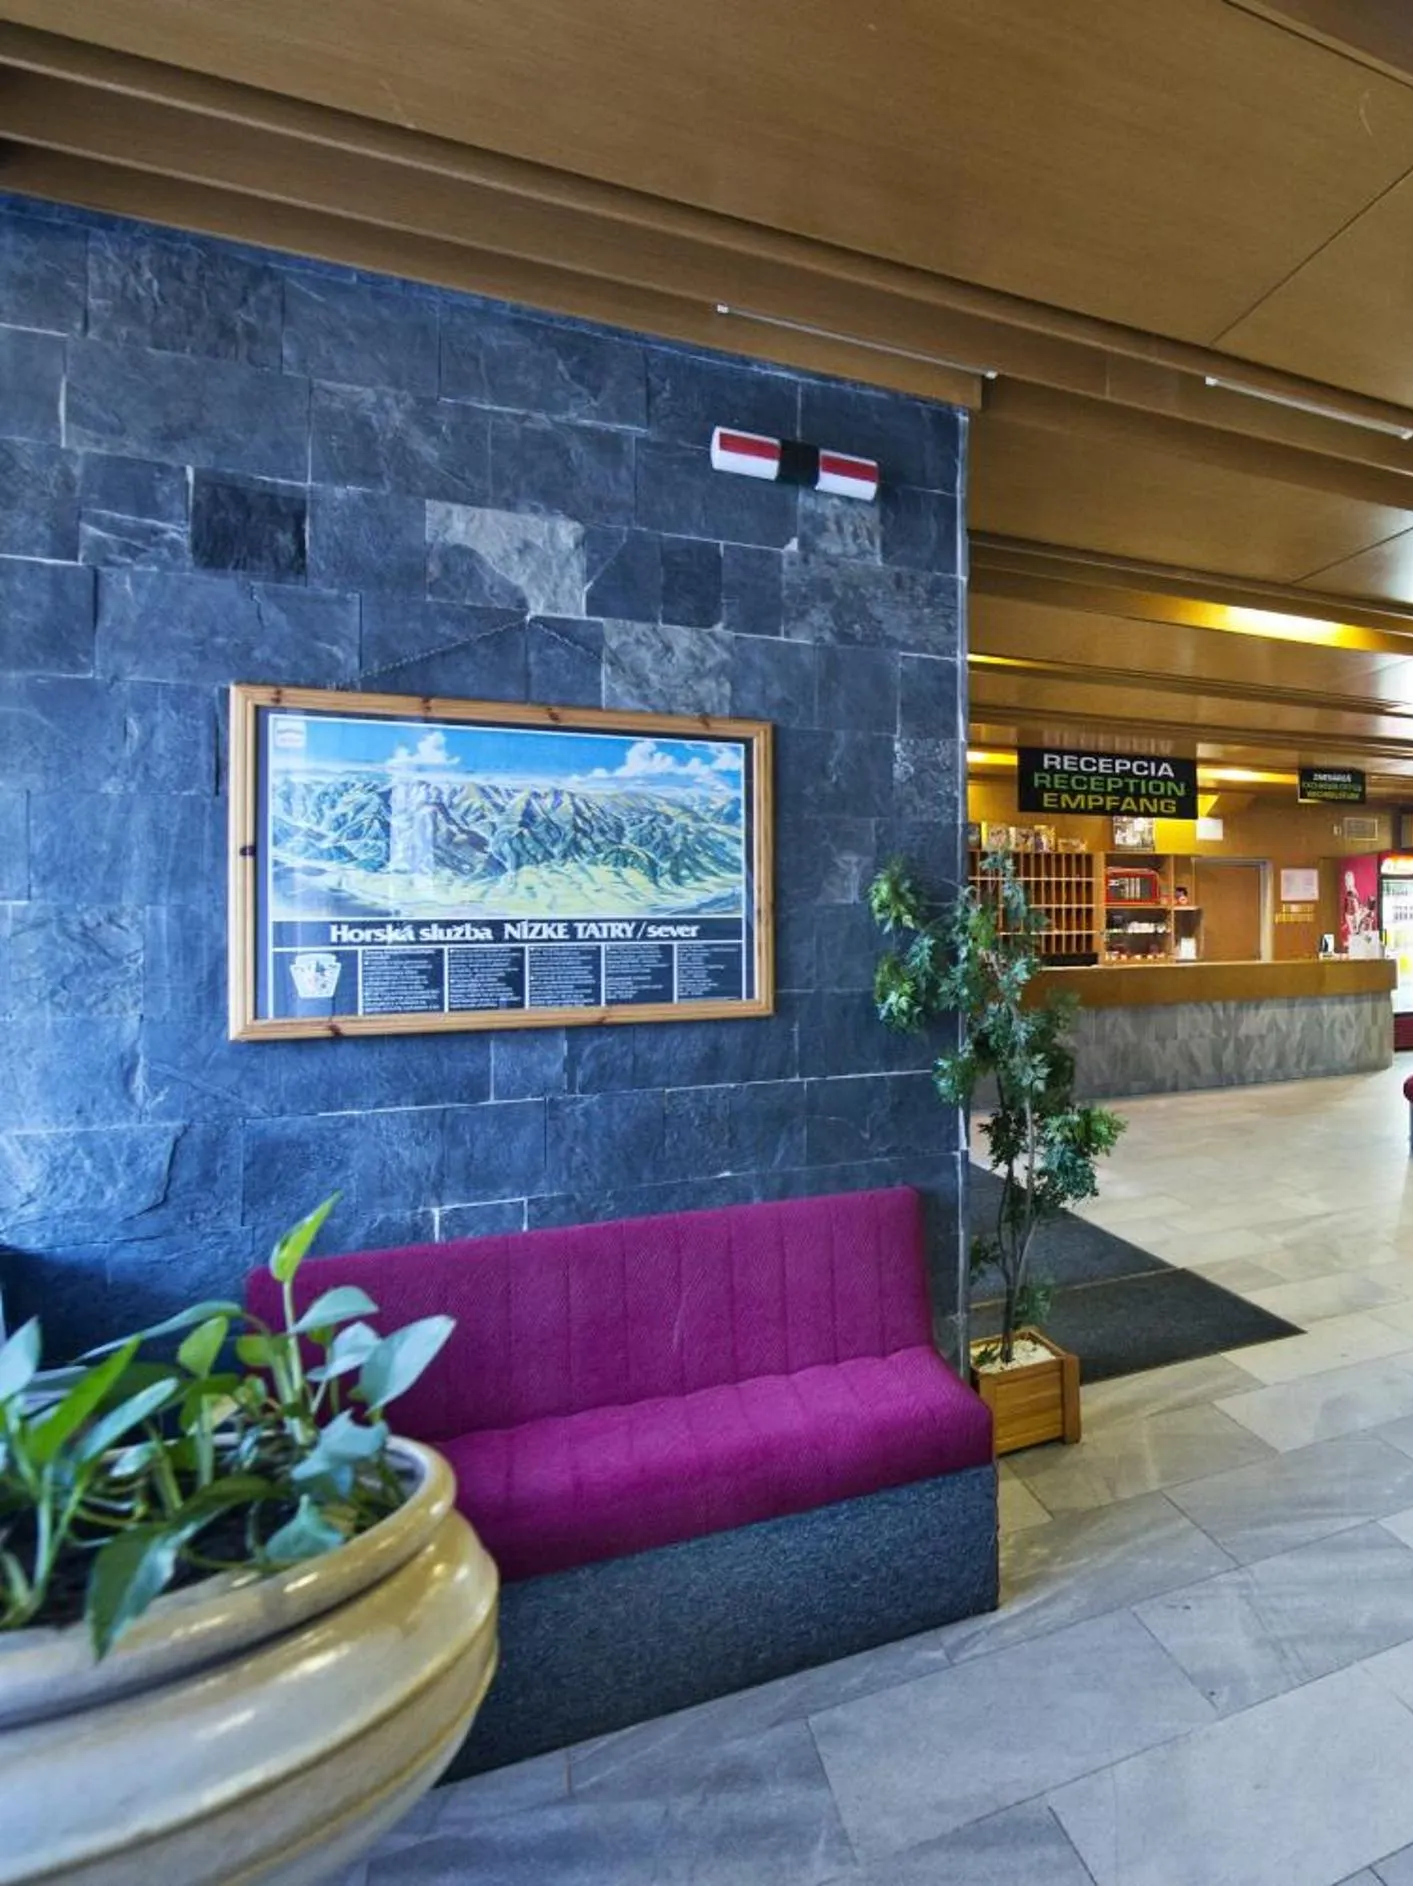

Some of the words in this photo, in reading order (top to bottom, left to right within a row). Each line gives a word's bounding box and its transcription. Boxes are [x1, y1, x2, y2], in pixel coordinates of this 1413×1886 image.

[1042, 752, 1175, 778] RECEPCIA
[1033, 771, 1186, 797] RECEPTION
[1043, 792, 1177, 814] EMPFANG
